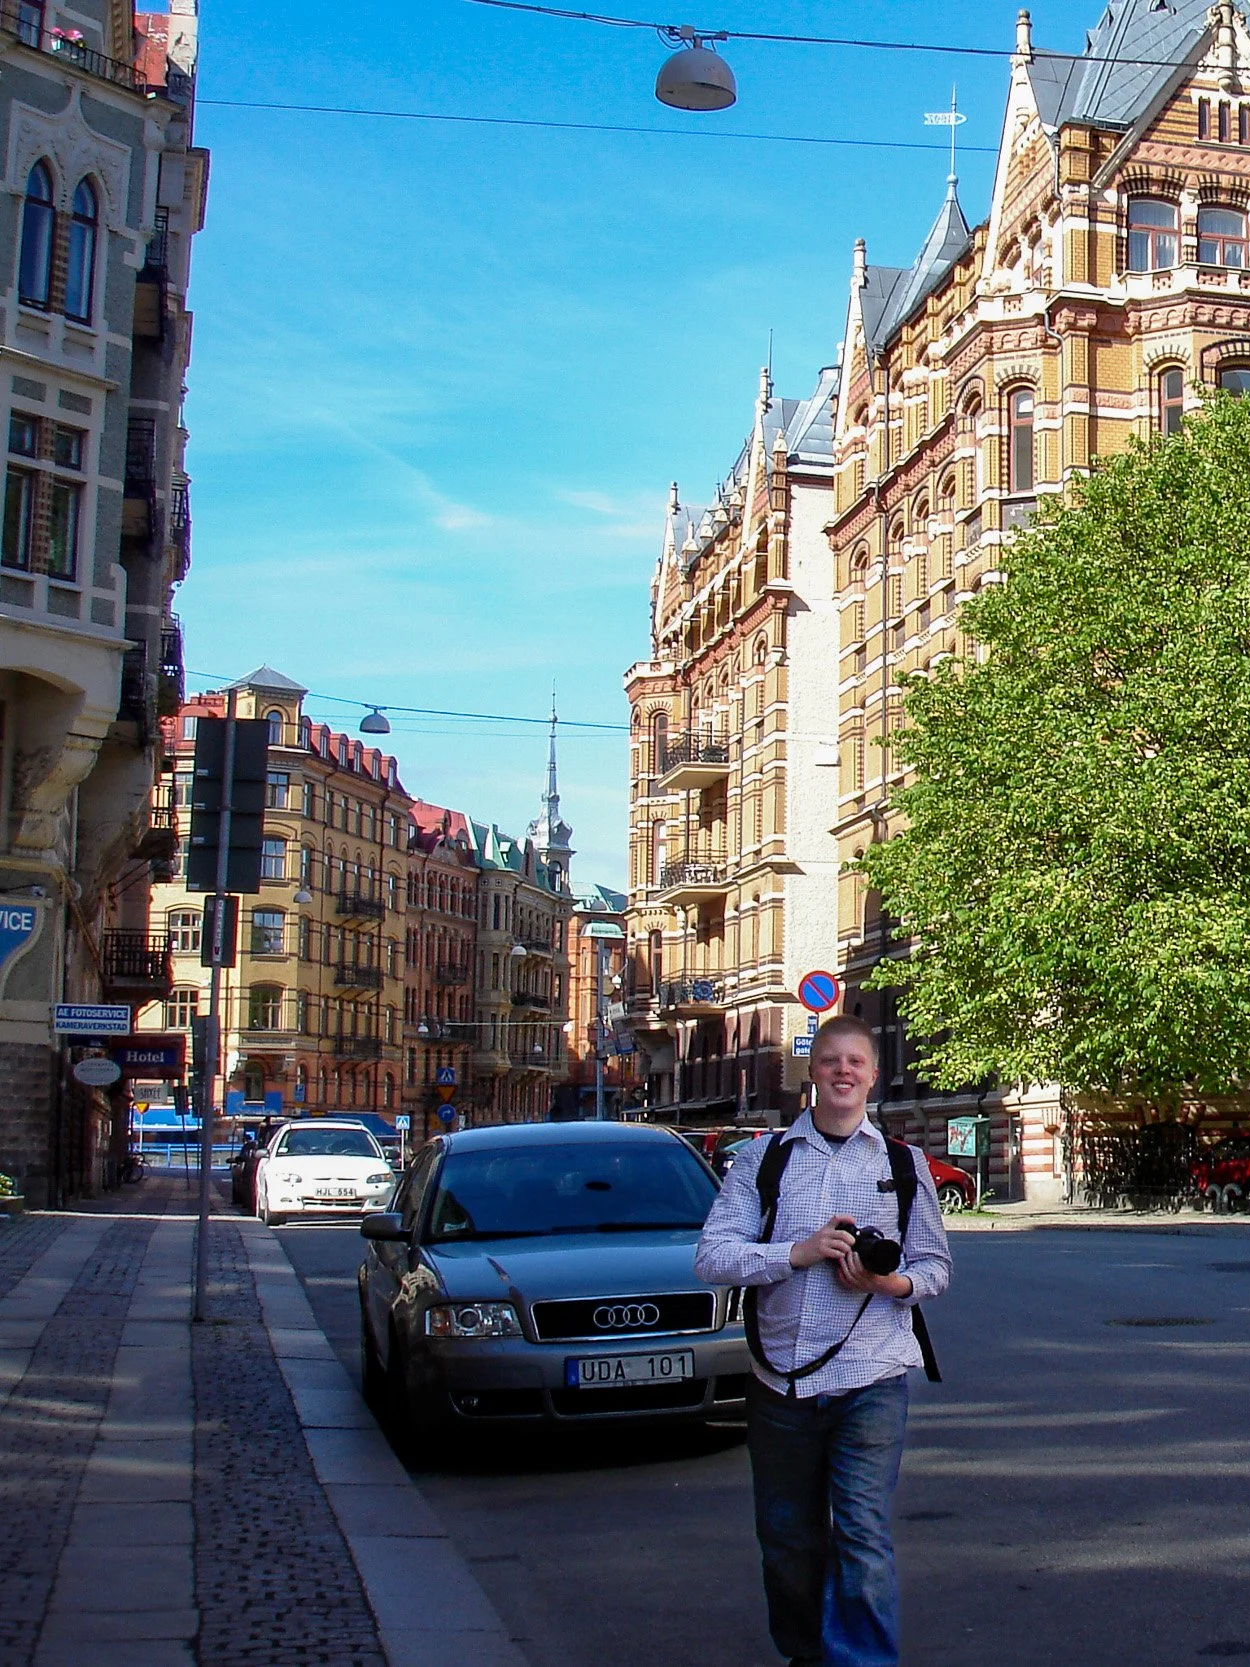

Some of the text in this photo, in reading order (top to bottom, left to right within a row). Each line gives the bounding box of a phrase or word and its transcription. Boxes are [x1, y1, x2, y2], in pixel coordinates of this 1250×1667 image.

[0, 911, 32, 931] ICE
[71, 1008, 128, 1019] FOTOSERVICE
[56, 1021, 128, 1032] KAMERAVERKSTAD
[127, 1050, 165, 1063] Hotel
[582, 1355, 686, 1381] UDA 101
